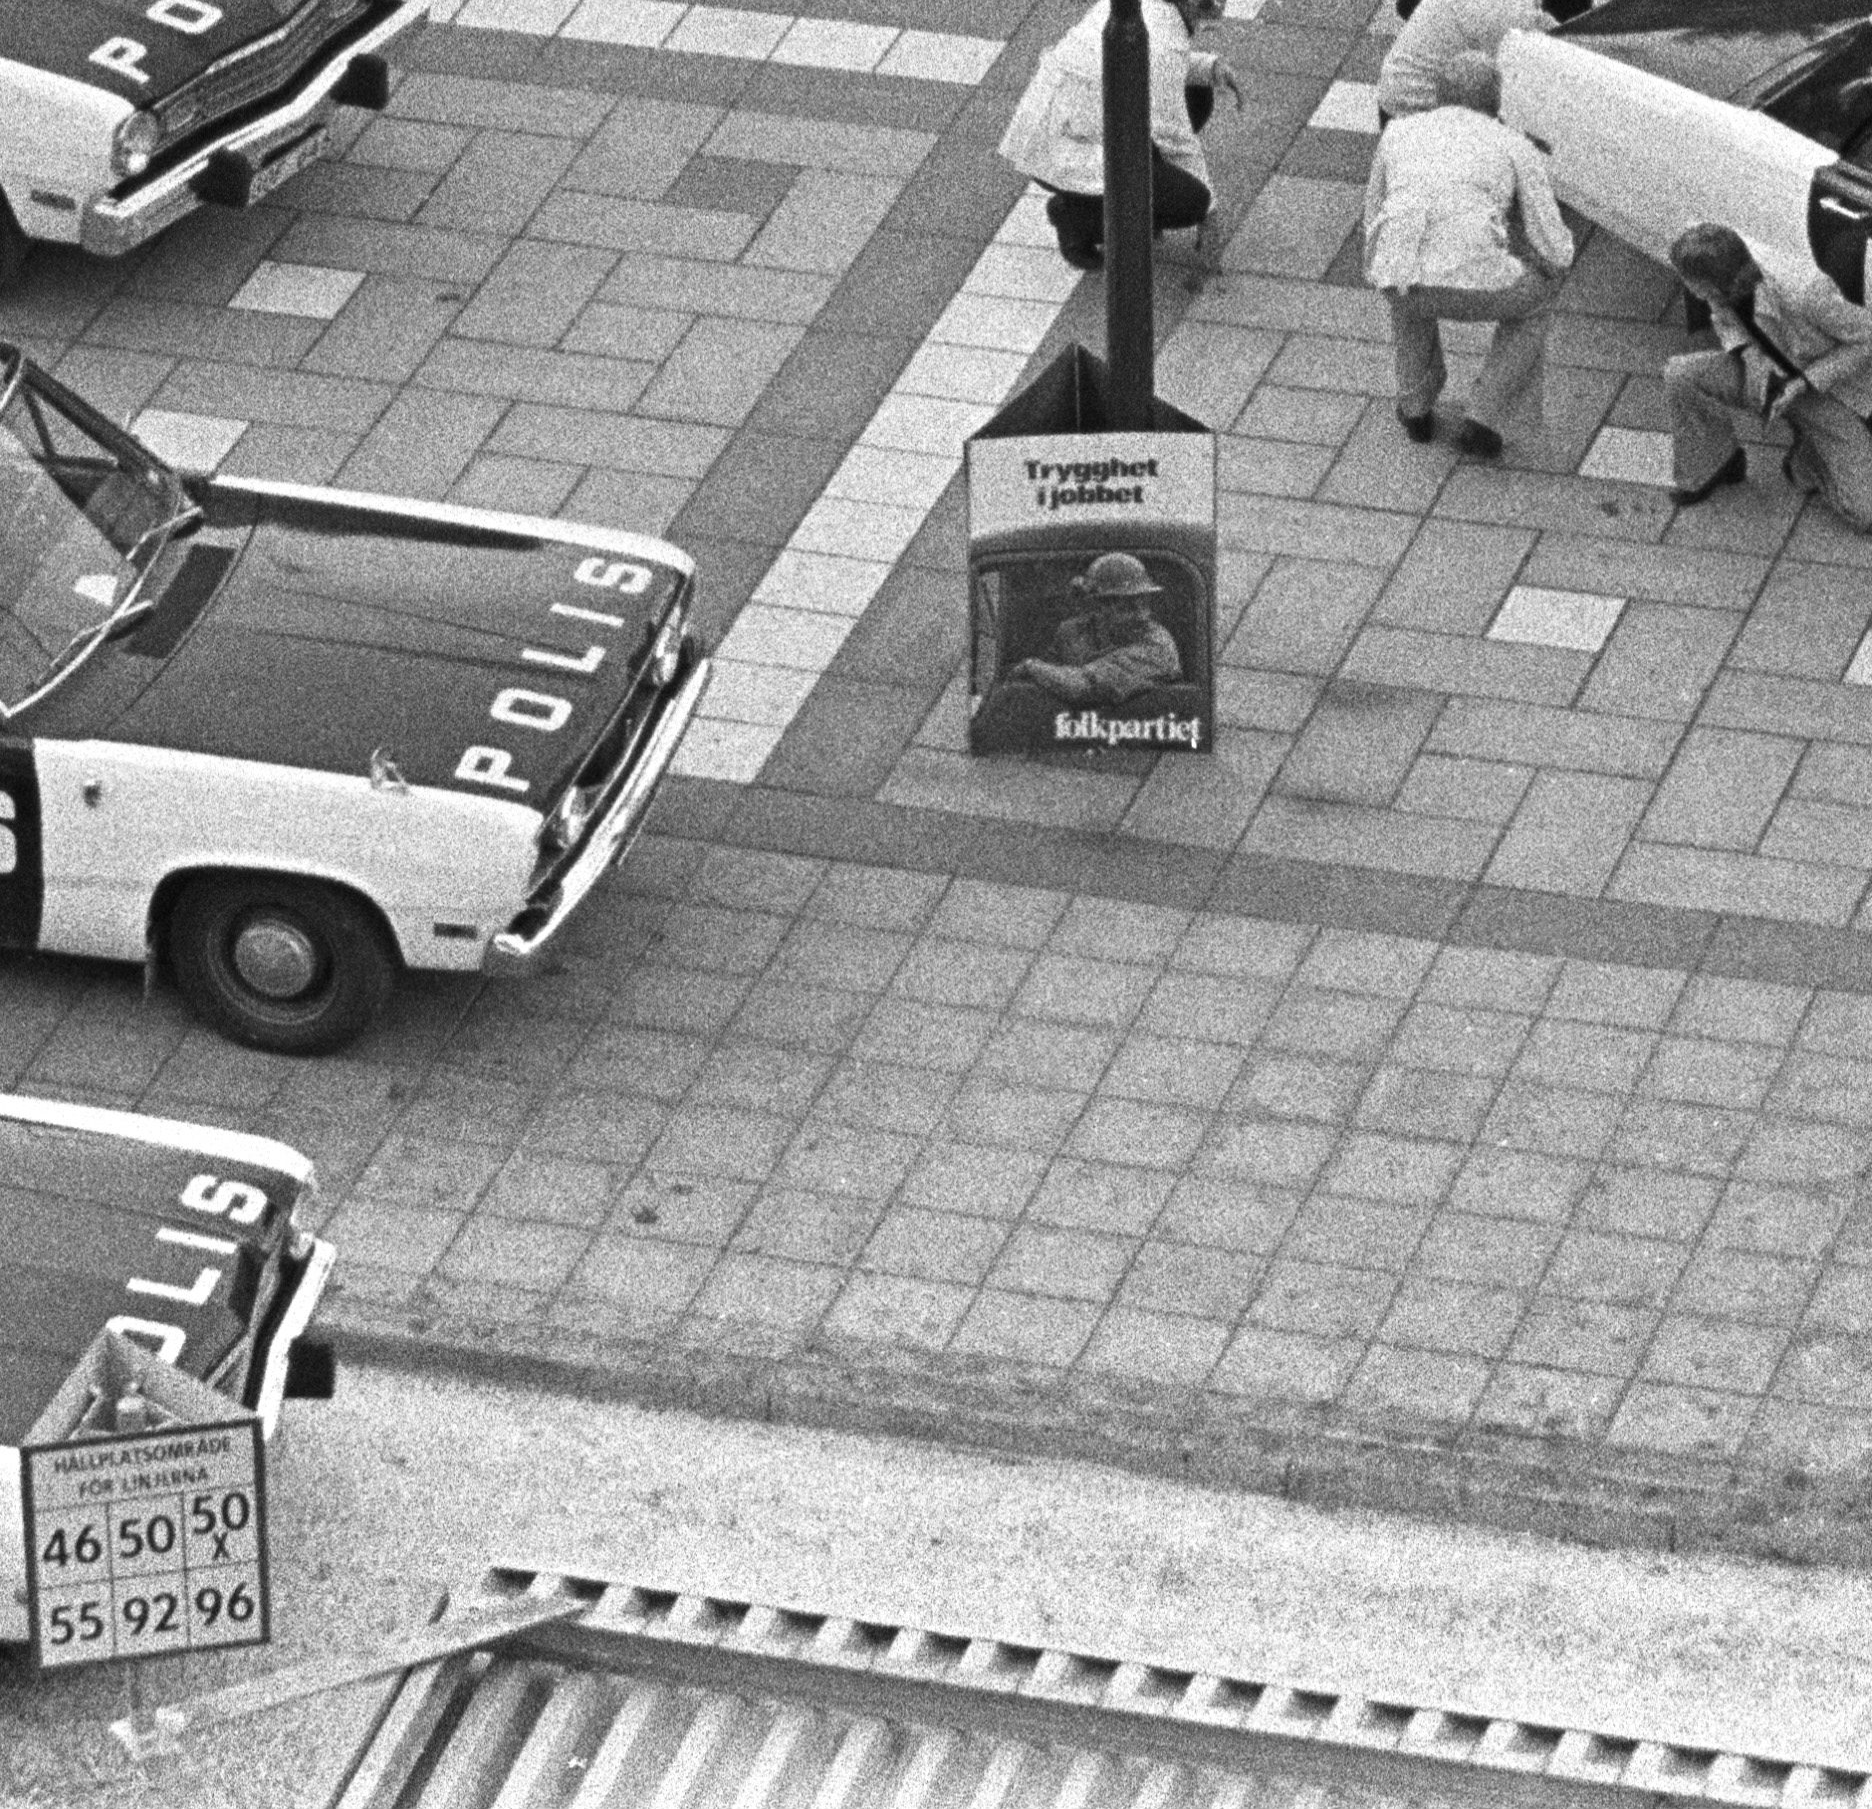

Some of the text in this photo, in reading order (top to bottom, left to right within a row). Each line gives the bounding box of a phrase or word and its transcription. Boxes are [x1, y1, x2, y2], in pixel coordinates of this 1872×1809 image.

[1024, 457, 1159, 483] Trygghet
[1037, 485, 1144, 511] i jobbet
[457, 554, 655, 793] POLIS
[1054, 710, 1202, 747] folkpartiet
[42, 1491, 250, 1567] 46 50 50
[50, 1581, 255, 1643] 55 92 96
